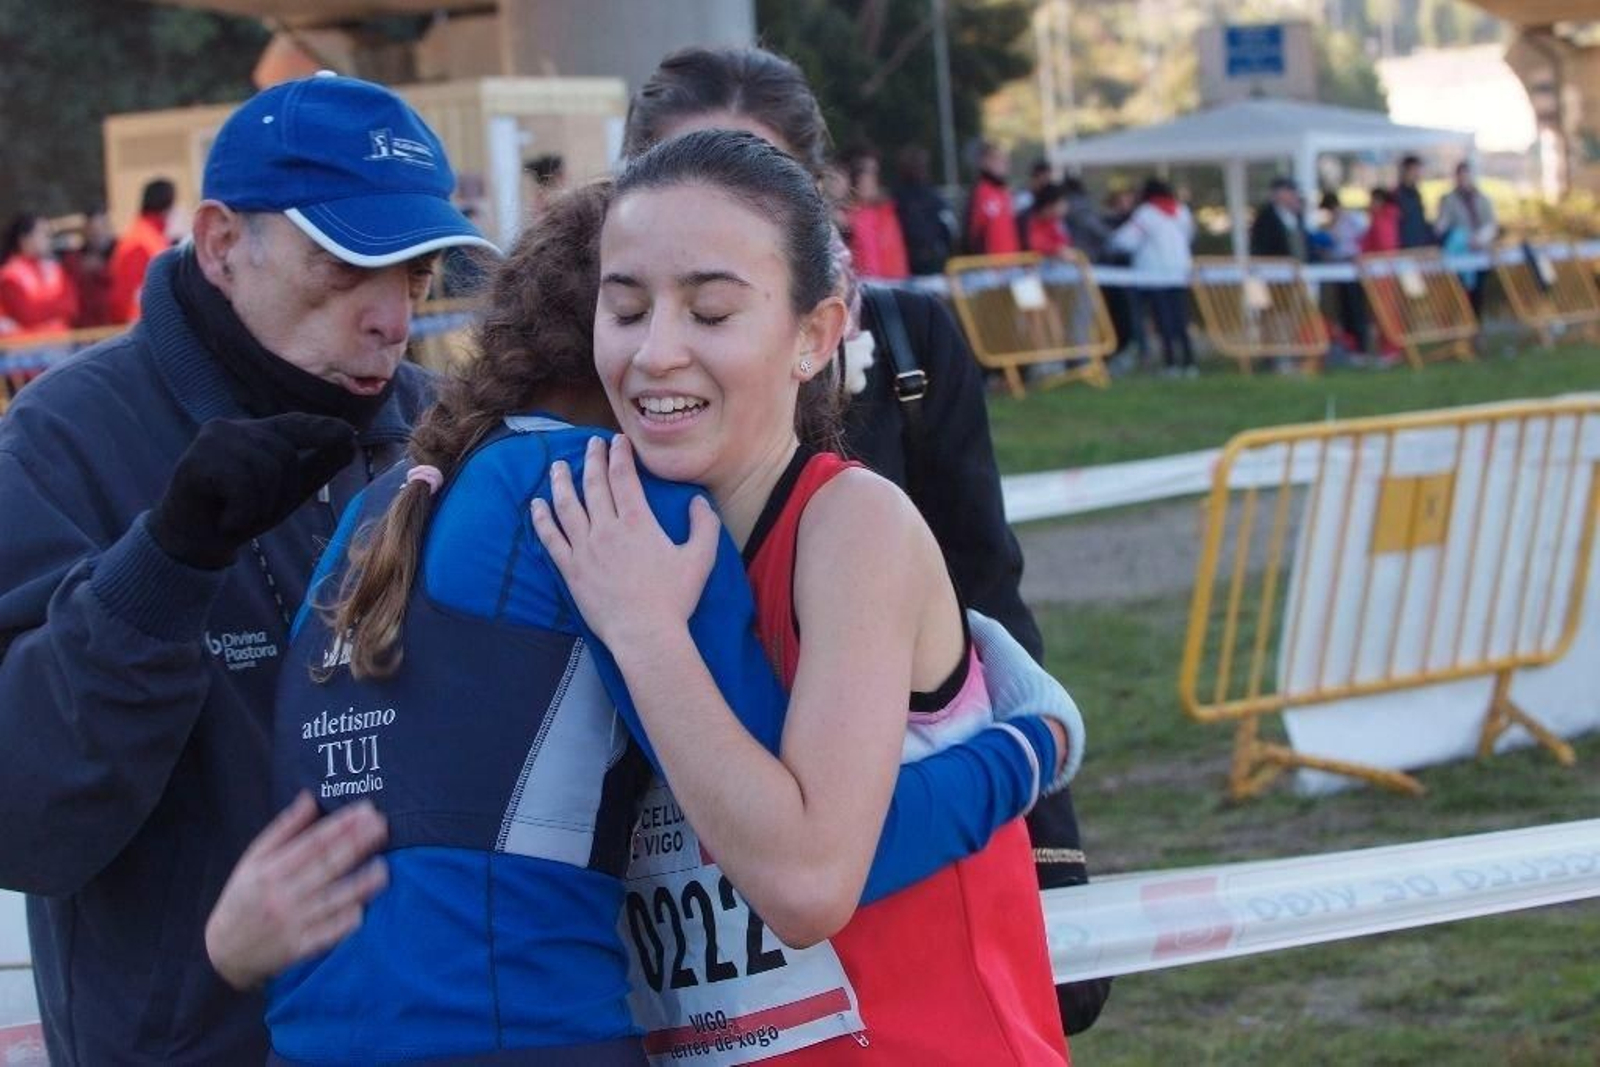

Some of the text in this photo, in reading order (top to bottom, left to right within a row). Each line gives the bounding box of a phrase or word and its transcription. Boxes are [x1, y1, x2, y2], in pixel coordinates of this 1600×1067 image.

[222, 631, 267, 648] Divina
[225, 644, 278, 662] Pastora
[302, 706, 396, 740] atletismo
[318, 735, 380, 778] TUI
[644, 830, 684, 857] VIGO
[626, 874, 788, 994] 0222
[715, 1033, 734, 1053] de
[738, 1025, 779, 1049] xogo
